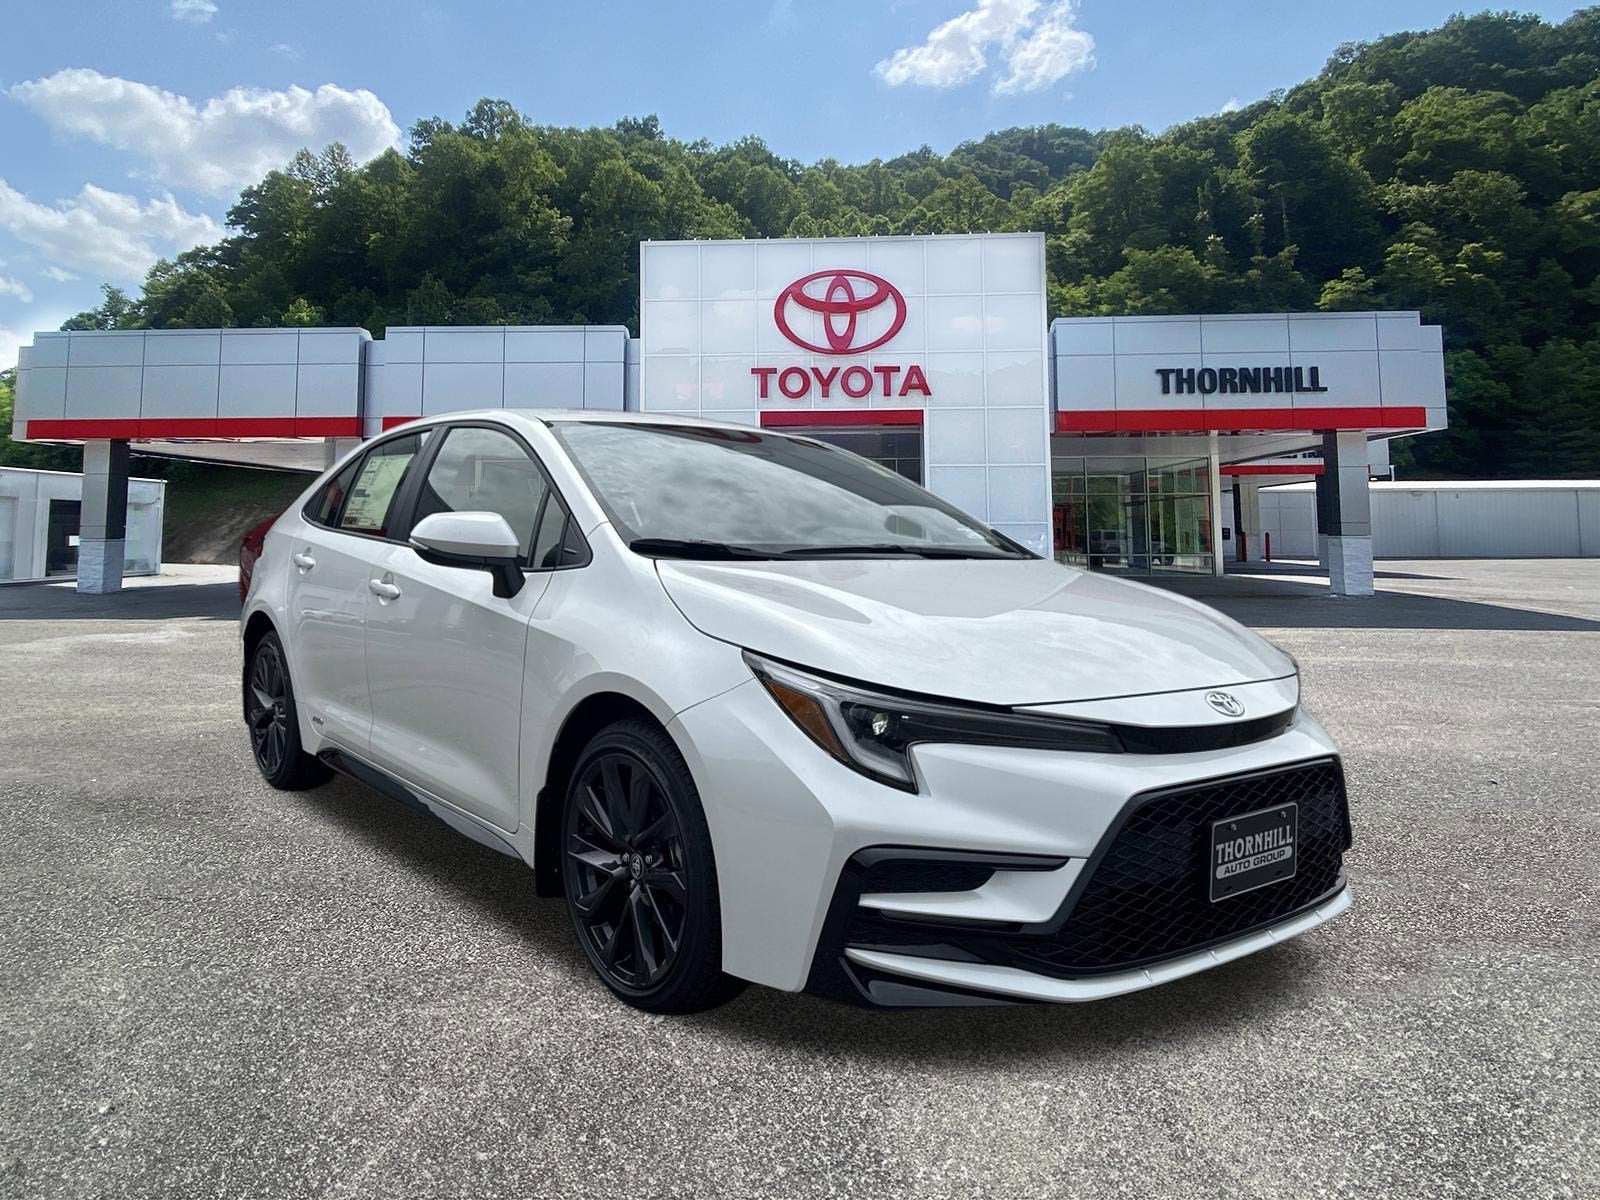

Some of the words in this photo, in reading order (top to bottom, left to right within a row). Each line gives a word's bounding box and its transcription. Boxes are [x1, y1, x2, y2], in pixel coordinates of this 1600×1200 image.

[751, 365, 932, 399] TOYOTA
[1156, 366, 1328, 394] THORNHILL
[1215, 825, 1293, 864] THORNHILL
[1224, 860, 1251, 876] AUTO
[1252, 849, 1286, 867] GROUP
